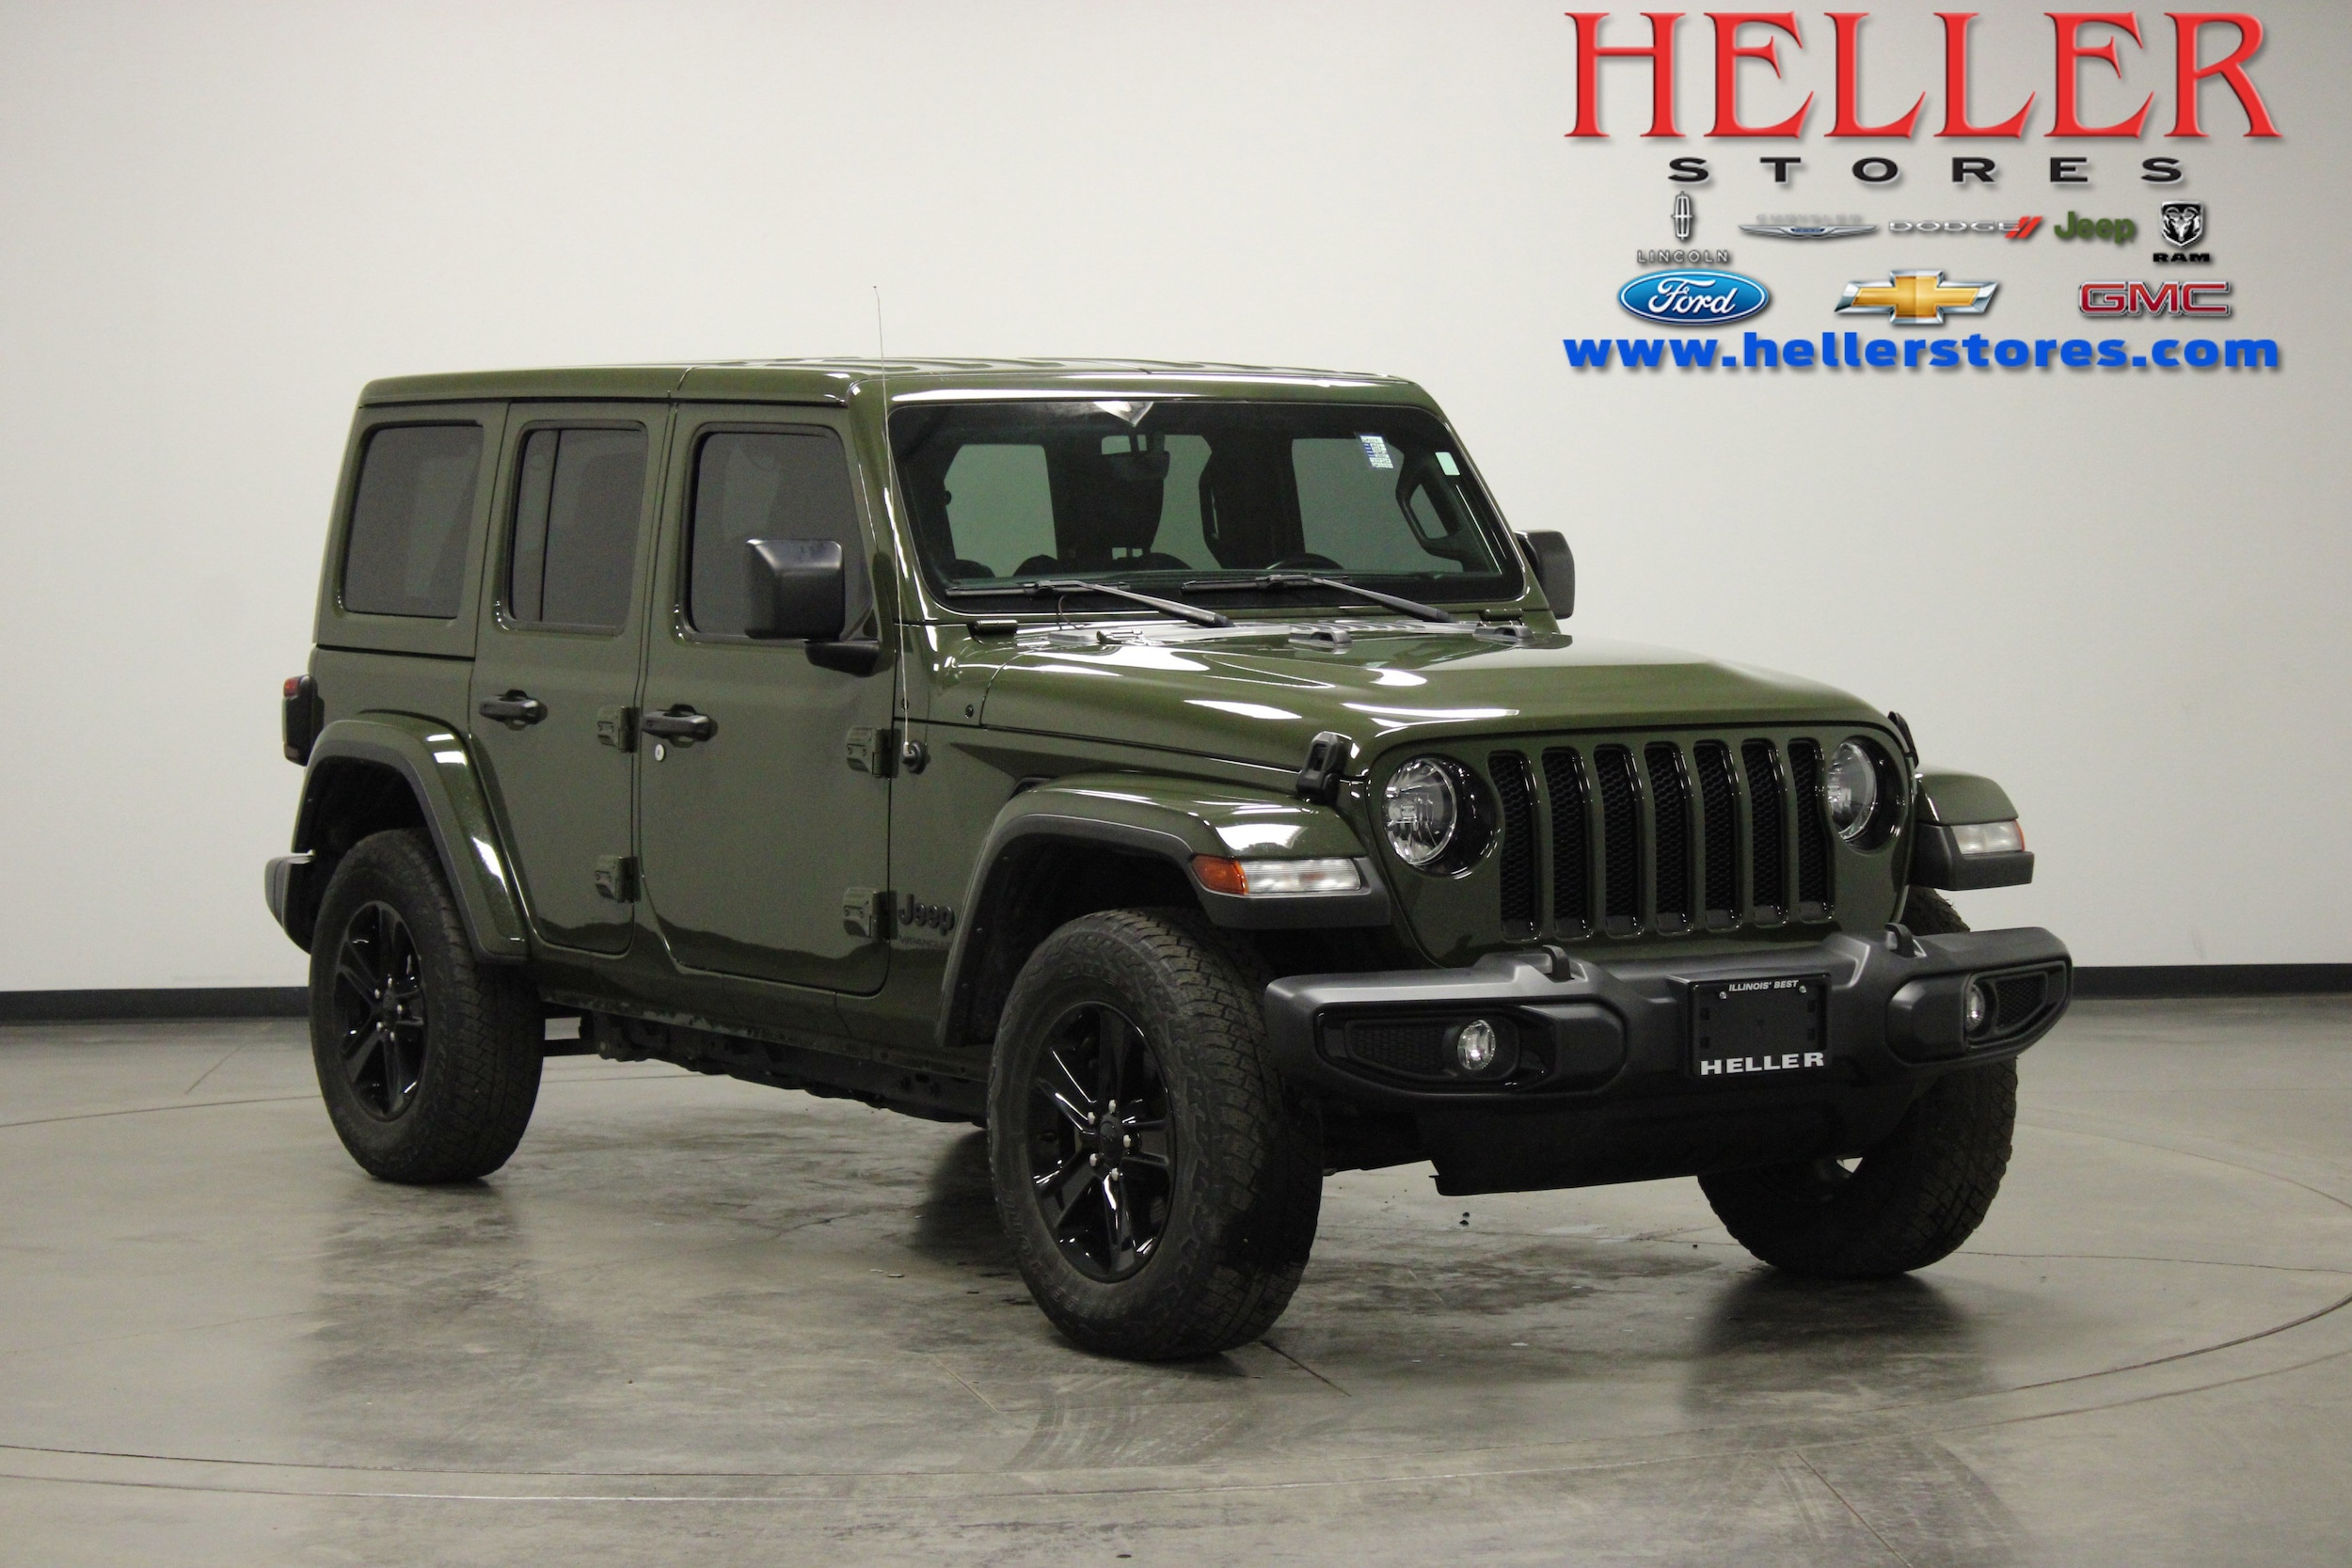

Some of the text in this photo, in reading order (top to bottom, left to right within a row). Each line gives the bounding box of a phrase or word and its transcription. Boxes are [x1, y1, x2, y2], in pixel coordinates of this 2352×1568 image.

[898, 894, 955, 937] Jeep
[1728, 979, 1799, 992] ILLINOIS' BEST
[1700, 1052, 1825, 1076] HELLER
